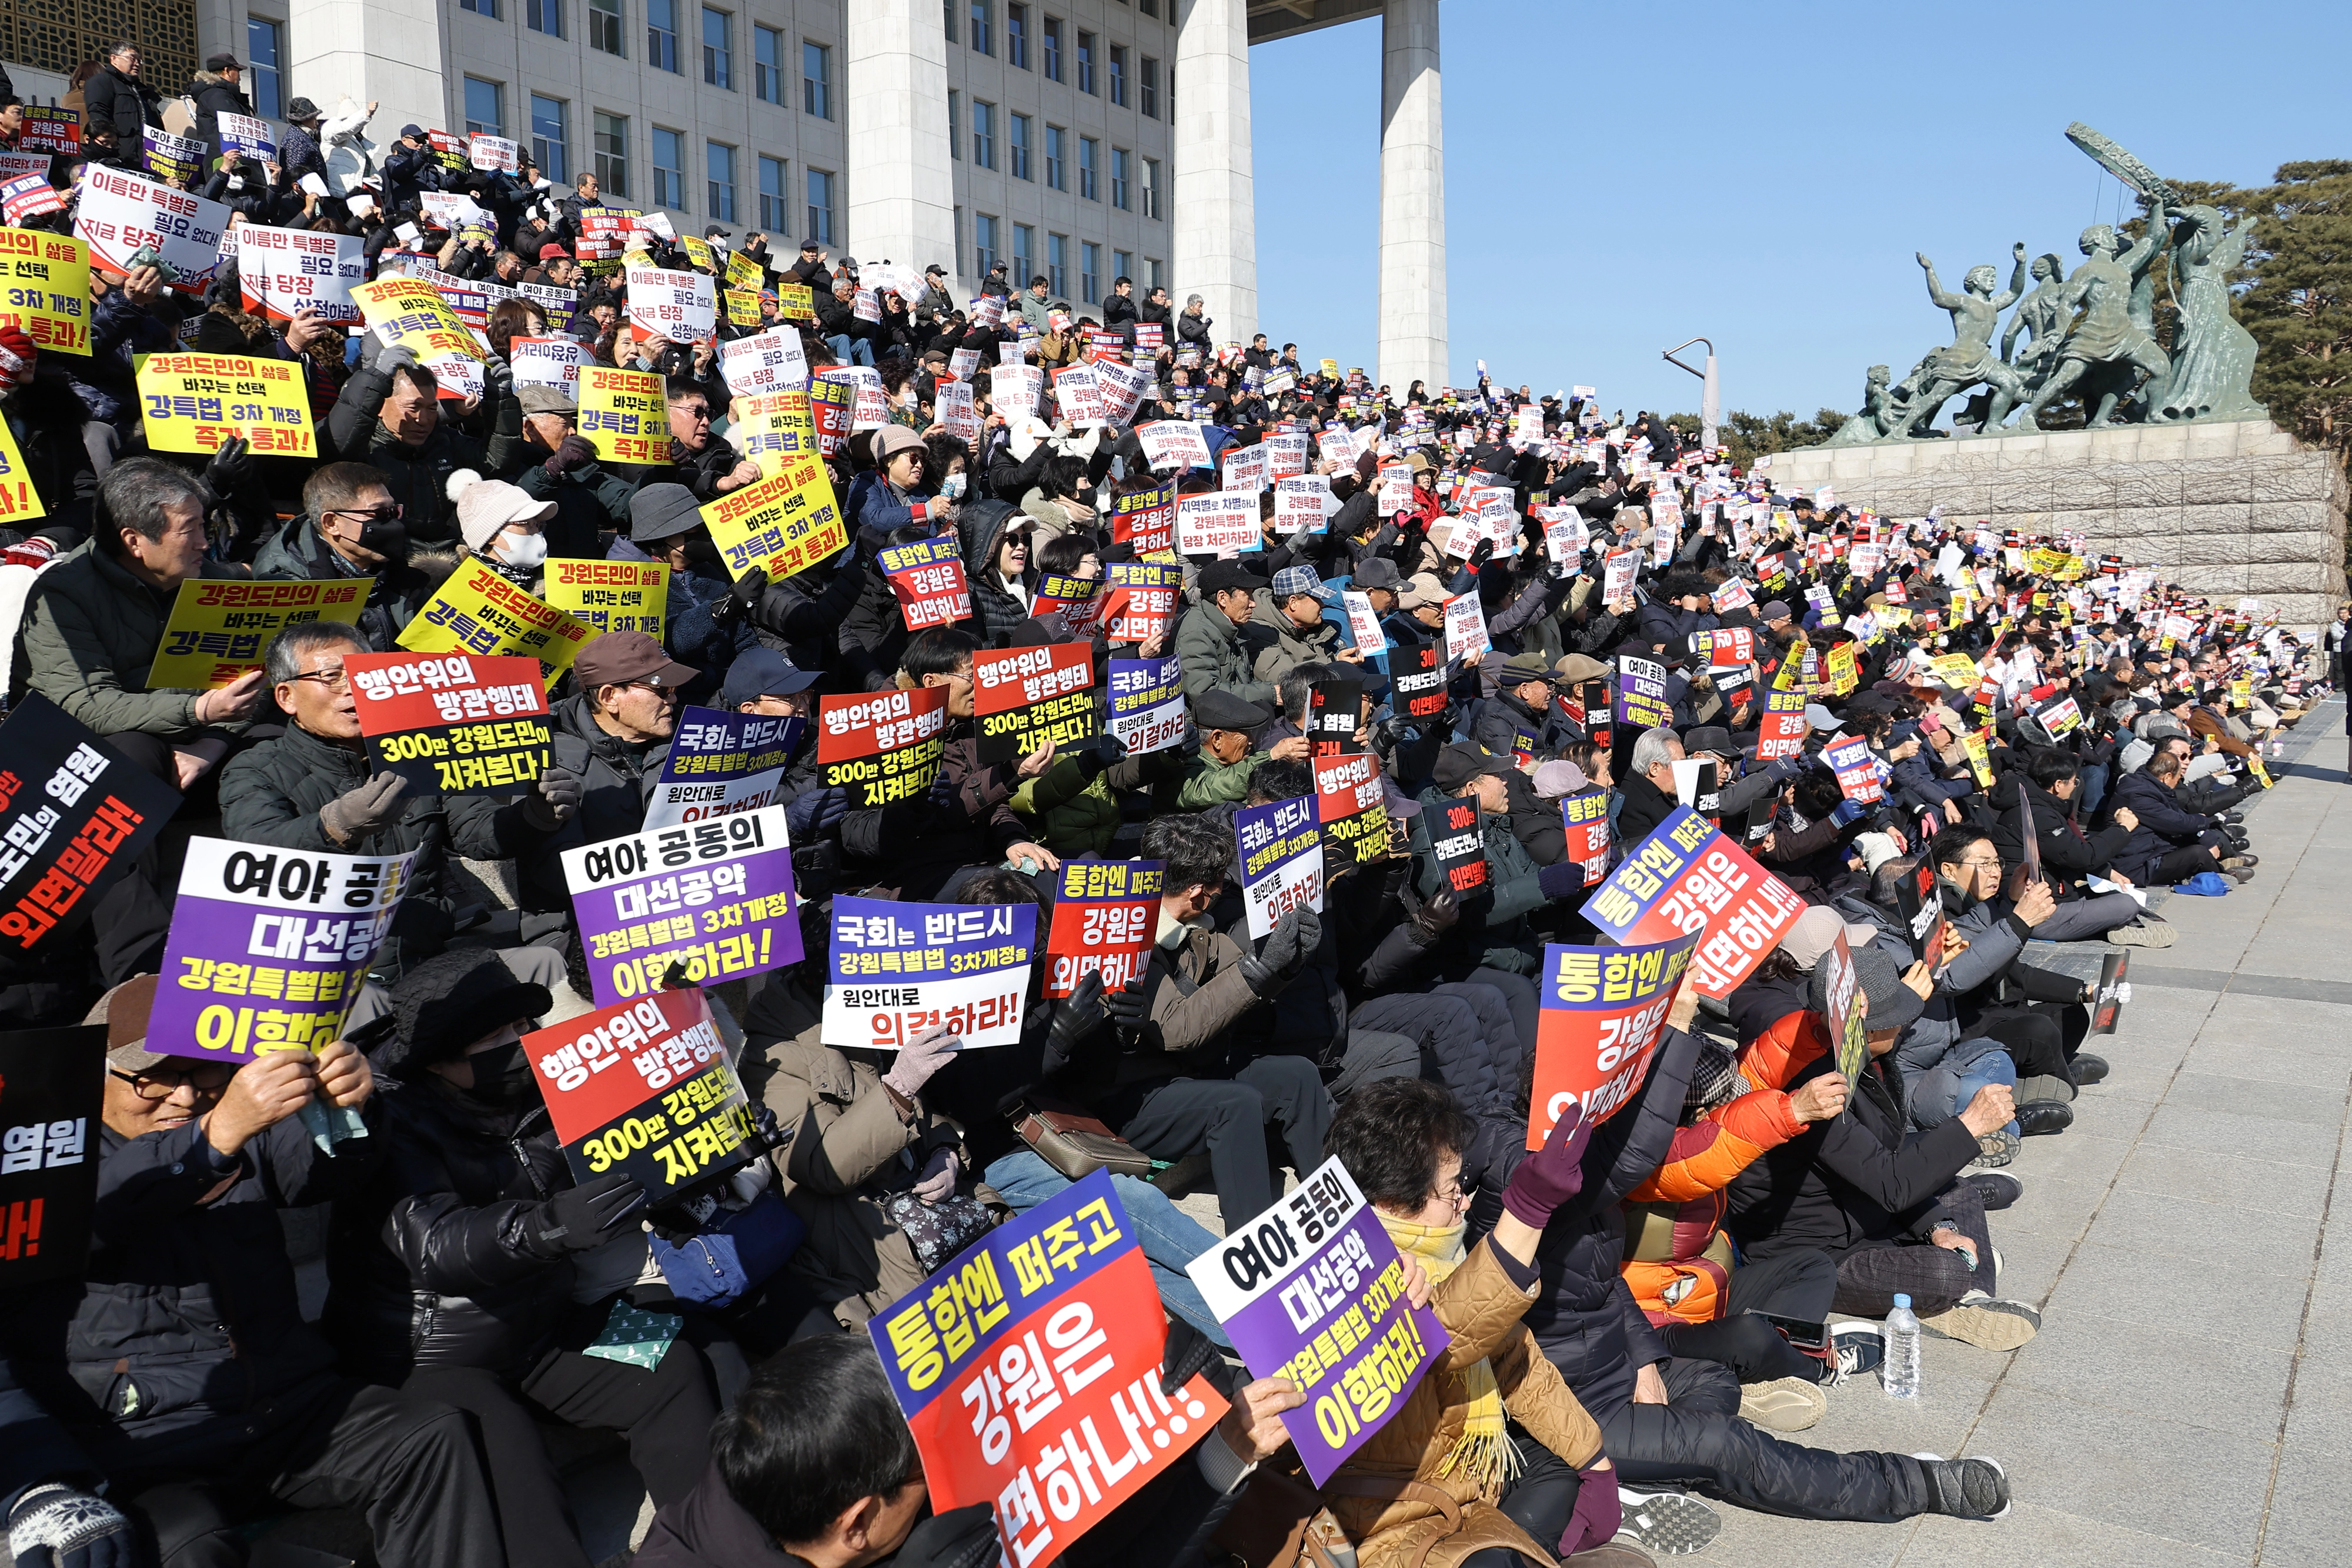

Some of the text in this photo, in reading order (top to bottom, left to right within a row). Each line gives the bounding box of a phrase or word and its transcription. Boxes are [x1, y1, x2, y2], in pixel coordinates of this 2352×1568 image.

[150, 129, 203, 153] 여야 공동의
[222, 133, 258, 147] 장기 계류를
[430, 133, 459, 146] 행안위의
[475, 136, 497, 148] 지역별로
[474, 156, 487, 166] 당장
[482, 148, 509, 159] 강원특별법
[92, 171, 198, 218] 이름만 특별은
[155, 210, 190, 239] 필요
[193, 227, 218, 247] 없다!
[592, 218, 619, 229] 강원은
[243, 229, 287, 249] 이름만
[293, 235, 336, 255] 특별은
[578, 240, 609, 250] 행안위의
[579, 259, 597, 268] 300만
[597, 249, 622, 258] 방관행태
[16, 262, 49, 281] 선택
[300, 255, 360, 278] 필요 없다!
[592, 266, 618, 276] 지켜본다!
[246, 273, 313, 295] 지금 당장
[477, 283, 494, 294] 여야
[632, 272, 695, 289] 이름만 특별은
[783, 285, 804, 293] 강원도민의
[464, 296, 485, 308] 미래
[524, 285, 572, 299] 여야 공동의
[673, 289, 712, 309] 필요 없다!
[727, 291, 746, 299] 강원도민의
[9, 289, 82, 316] 3차 개정
[402, 299, 436, 310] 바꾸는
[634, 305, 683, 320] 지금 당장
[781, 299, 798, 309] 강특법
[1093, 335, 1124, 344] 강원의 미래
[1135, 326, 1151, 334] 강원의
[754, 336, 781, 350] 특별은
[954, 349, 967, 357] 이름만
[763, 350, 803, 366] 필요 없다!
[149, 356, 290, 381] 강원도민의 삶을
[442, 363, 467, 378] 당장
[733, 368, 774, 388] 지금 당장
[183, 379, 266, 397] 바꾸는 선택
[1057, 372, 1090, 386] 지역별로
[613, 396, 649, 410] 바꾸는
[230, 404, 302, 424] 3차 개정
[771, 414, 803, 429] 바꾸는
[1067, 409, 1085, 420] 당장
[251, 427, 309, 452] 통과!
[1140, 424, 1200, 438] 지역별로 차별하나
[1155, 437, 1198, 449] 강원특별법
[1225, 452, 1249, 466] 지역별로
[1274, 452, 1302, 463] 강원특별법
[1278, 480, 1328, 493] 지역별로 차별하나
[713, 473, 793, 523] 강원도민의
[1181, 496, 1256, 513] 지역별로 차별하나
[1289, 496, 1321, 509] 강원특별법
[744, 493, 806, 531] 바꾸는 선택
[1194, 514, 1246, 529] 강원특별법
[1278, 514, 1295, 527] 당장
[1182, 535, 1205, 548] 당장
[1548, 526, 1568, 539] 지역별로
[769, 523, 843, 577] 즉각 통과!
[1449, 537, 1466, 553] 당장
[1853, 546, 1873, 554] 지역별로
[881, 543, 930, 571] 통합엔
[558, 563, 638, 586] 강원도민의
[910, 564, 957, 594] 강원은
[1164, 573, 1181, 586] 퍼주고
[196, 584, 320, 607] 강원도민의
[467, 569, 562, 630] 강원도민의
[582, 589, 642, 606] 바꾸는 선택
[1723, 587, 1739, 601] 강원은
[1810, 588, 1828, 597] 여야
[1446, 602, 1469, 618] 지역별로
[476, 604, 522, 637] 바꾸는
[1456, 617, 1481, 633] 강원특별법
[1449, 641, 1465, 655] 당장
[977, 647, 1053, 687] 행안위의
[1629, 660, 1647, 676] 여야
[1742, 669, 1752, 683] 염원
[353, 655, 477, 701] 행안위의
[1023, 662, 1088, 701] 방관행태
[1112, 670, 1157, 693] 국회는
[1396, 671, 1440, 693] 강원도민의
[1634, 678, 1663, 698] 대선공약
[432, 683, 540, 722] 방관행태
[1114, 686, 1167, 713] 강원특별법
[1623, 691, 1651, 707] 강원특별법
[1768, 693, 1805, 711] 통합엔
[823, 691, 911, 737] 행안위의
[1117, 712, 1155, 734] 원안대로
[1323, 713, 1355, 733] 염원
[1627, 705, 1663, 728] 이행하라!
[983, 714, 1029, 737] 300만
[379, 733, 447, 763] 300만
[1317, 757, 1370, 795] 행안위의
[1566, 792, 1608, 823] 통합엔
[1240, 804, 1311, 851] 국회는 반드시
[1447, 805, 1475, 831] 300만
[584, 814, 764, 883] 여야 공동의
[1434, 834, 1478, 861] 강원도민의
[222, 850, 333, 904] 여야
[1591, 812, 1713, 928] 통합엔 퍼주고
[1064, 864, 1162, 897] 통합엔 퍼주고
[613, 863, 747, 922] 대선공약
[1658, 851, 1750, 934] 강원은
[837, 905, 1013, 948] 국회는 반드시
[1083, 905, 1147, 946] 강원은
[838, 944, 1027, 975] 강원특별법 3차개정을
[1555, 947, 1666, 1003] 통합엔
[843, 988, 920, 1009] 원안대로
[539, 997, 671, 1092] 행안위의
[582, 1113, 670, 1174] 300만
[1222, 1166, 1355, 1292] 여야 공동의
[1278, 1227, 1375, 1335] 대선공약
[884, 1196, 1123, 1392] 통합엔 퍼주고
[960, 1300, 1116, 1466] 강원은
[1314, 1308, 1426, 1449] 이행하라!
